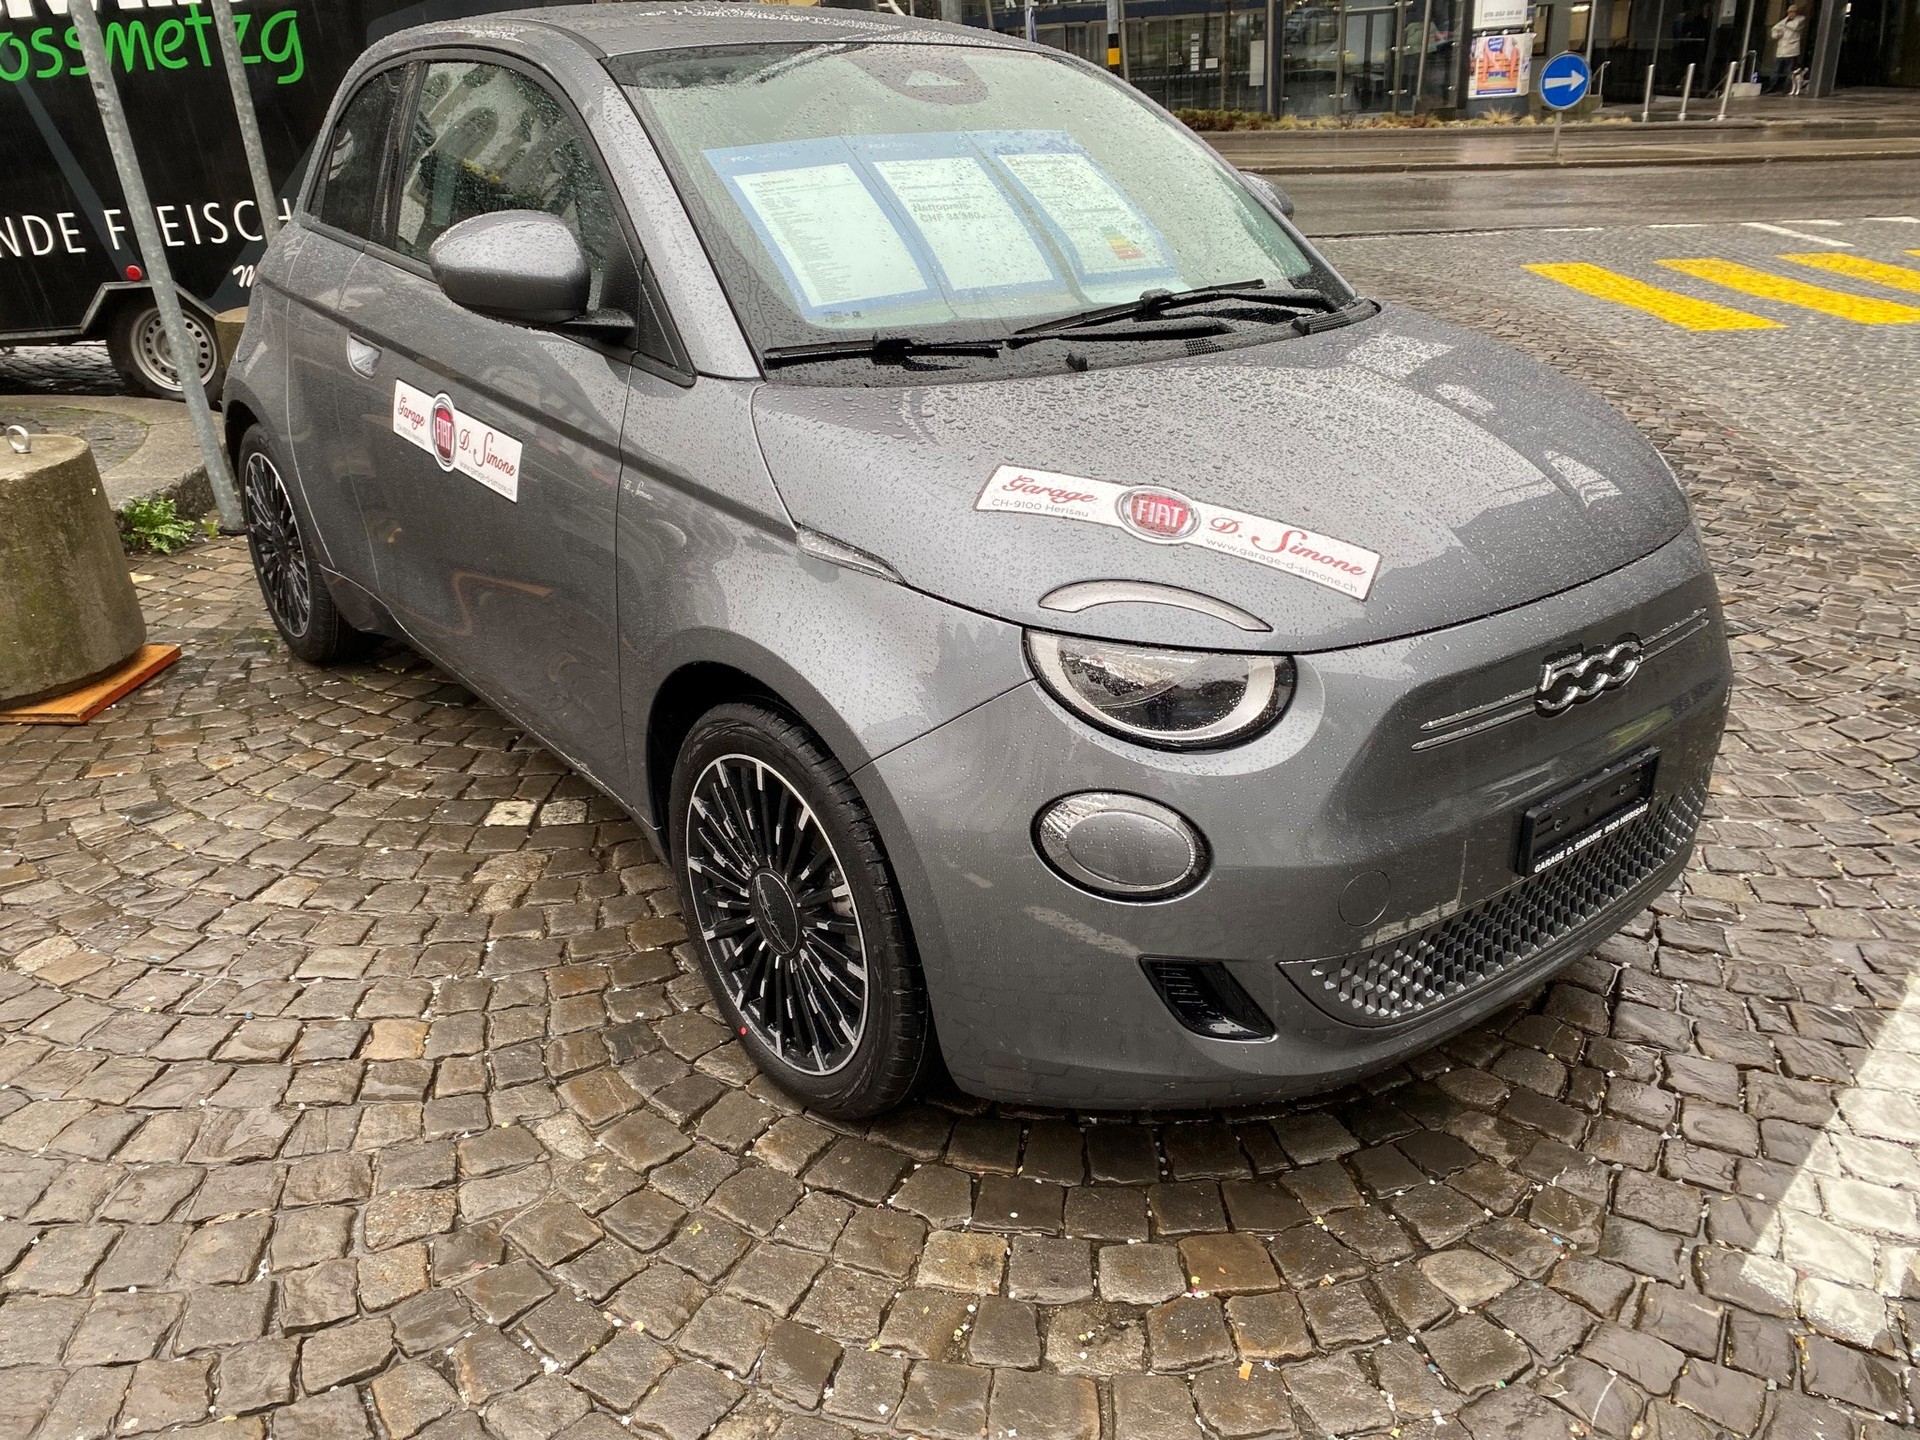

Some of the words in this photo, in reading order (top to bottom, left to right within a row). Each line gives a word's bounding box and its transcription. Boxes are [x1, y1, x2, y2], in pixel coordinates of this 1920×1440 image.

[397, 396, 425, 431] Garage
[436, 417, 453, 450] FIAT
[459, 429, 472, 454] D.
[473, 431, 516, 477] Simone
[991, 498, 1042, 511] CH-9100
[1045, 504, 1089, 517] Herisau
[1001, 475, 1098, 504] Garage
[1135, 498, 1184, 530] FIAT
[1206, 538, 1358, 593] www.garage-d-simone.ch
[1208, 517, 1244, 539] D.
[1251, 529, 1368, 577] Simone
[1536, 641, 1643, 712] 500
[1534, 850, 1565, 874] GARAGE
[1574, 829, 1603, 851] SIMONE
[1604, 819, 1620, 834] 9100
[1619, 803, 1649, 826] HERISAU
